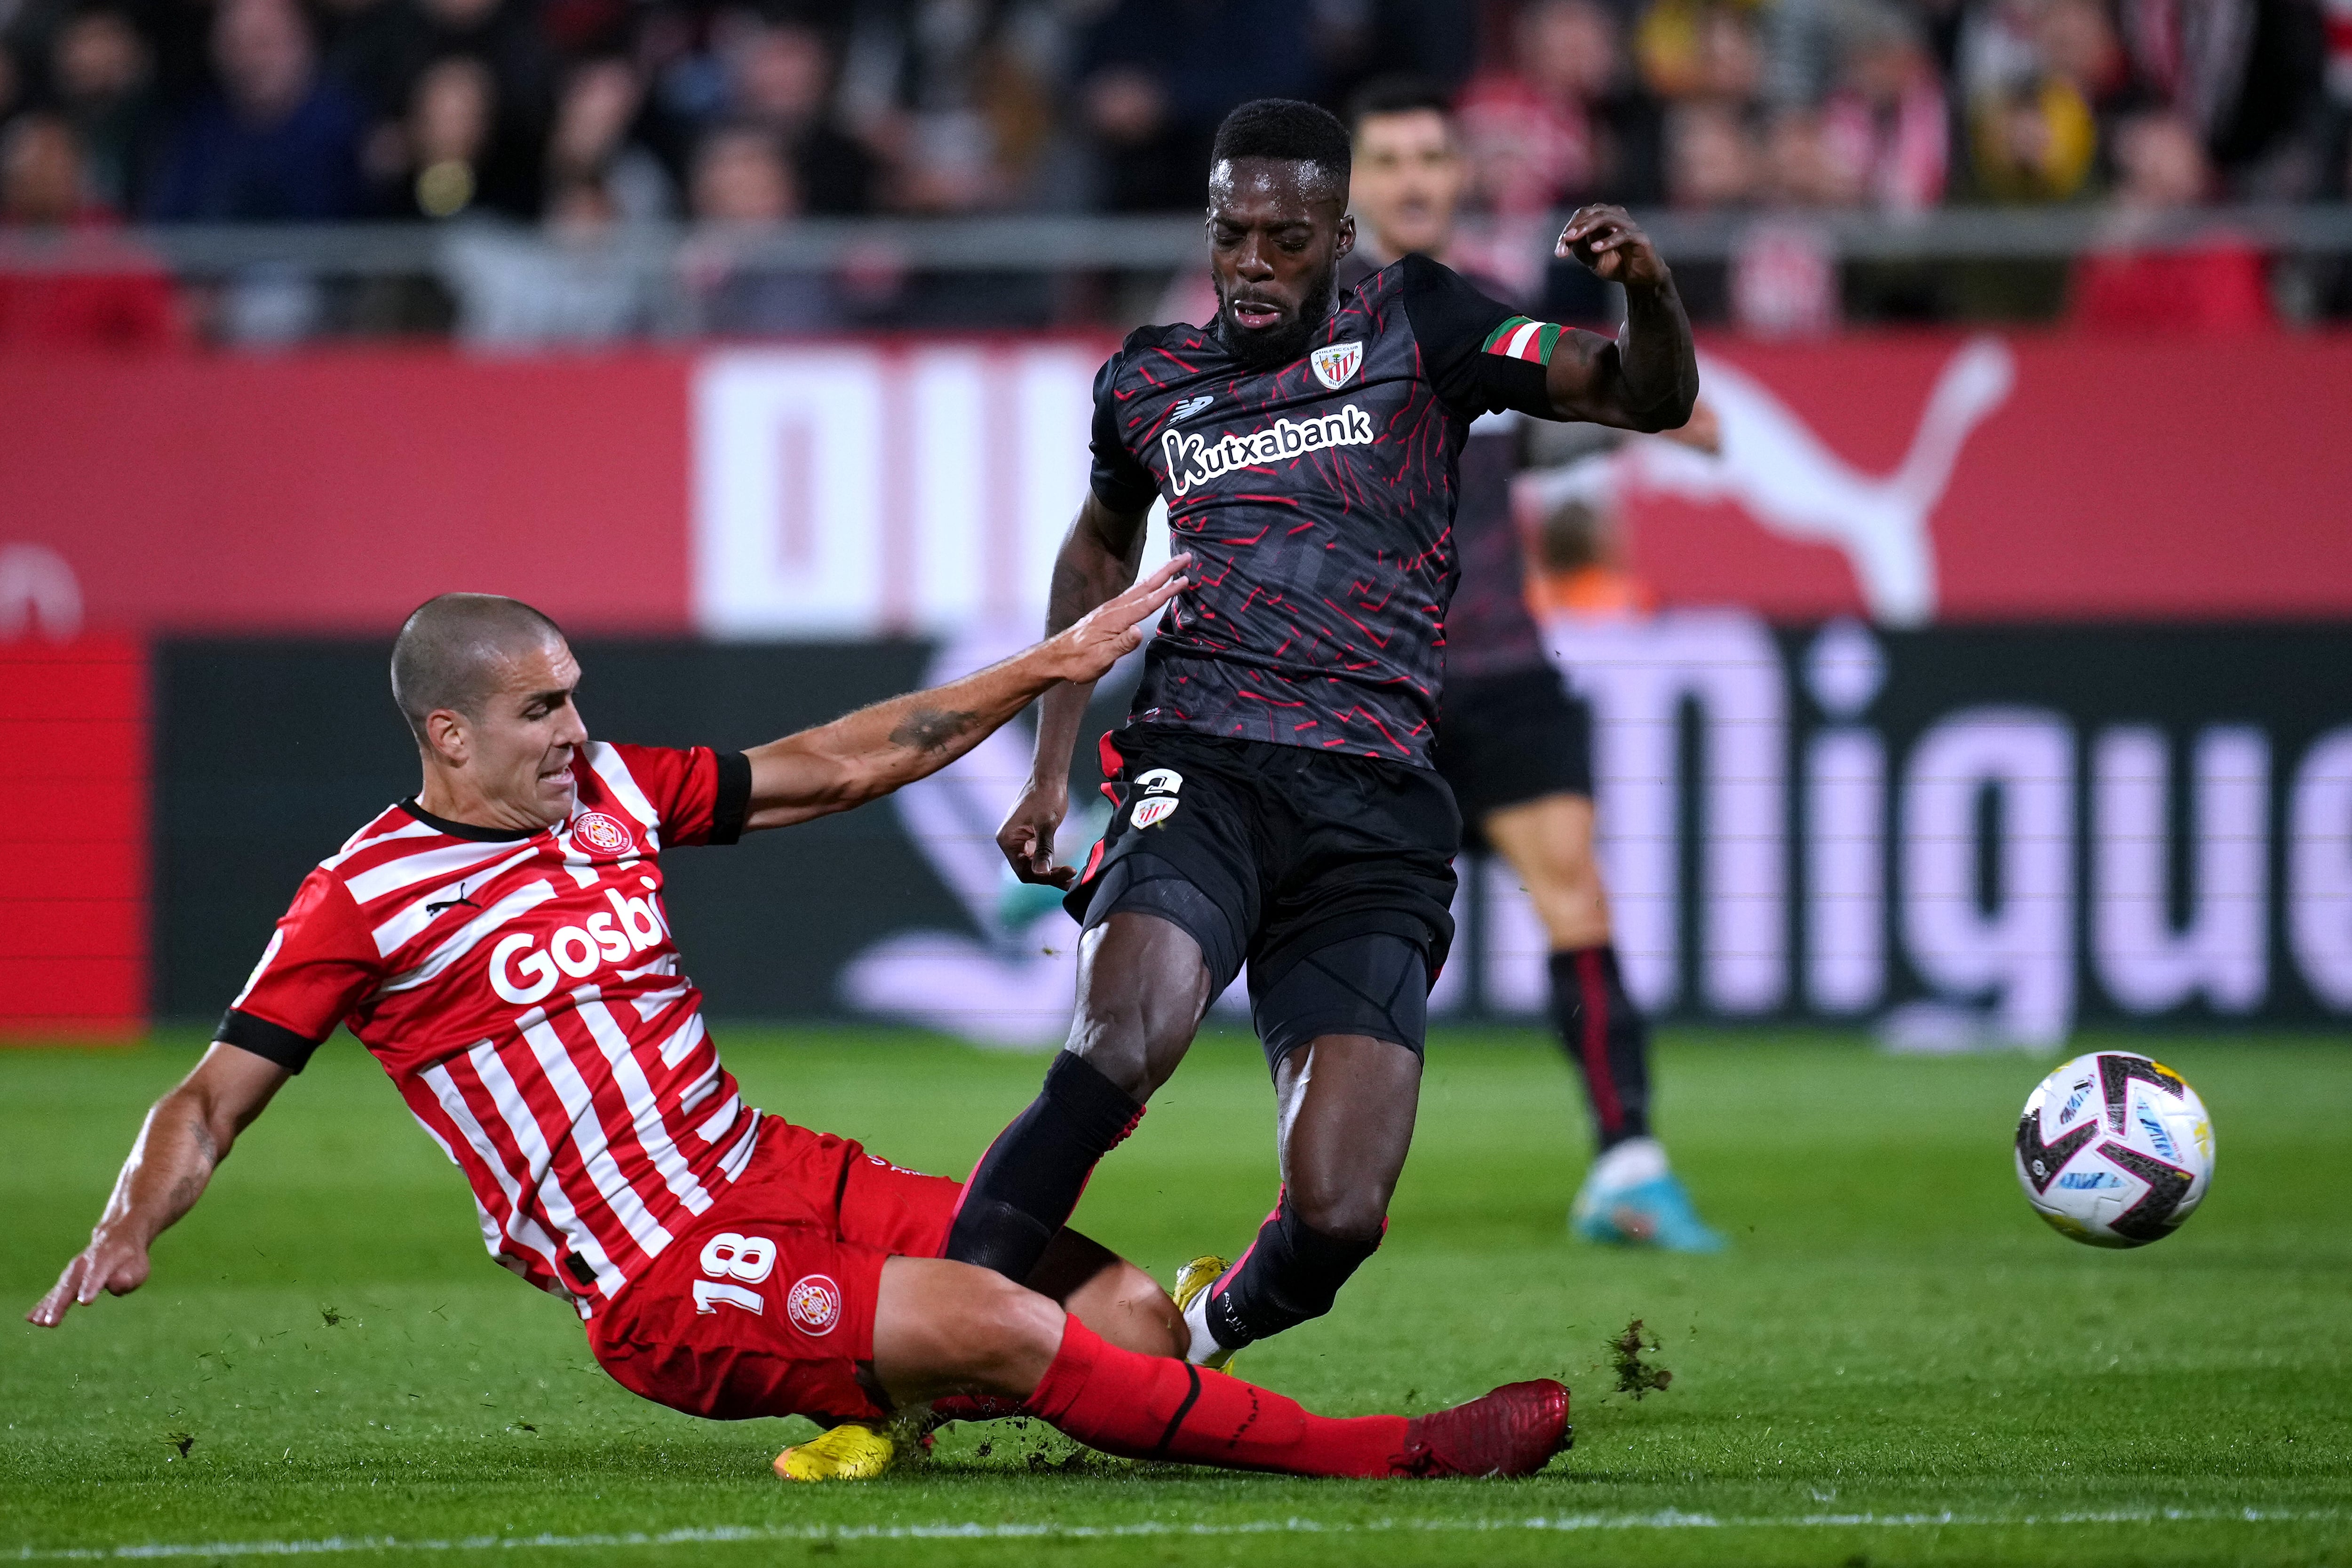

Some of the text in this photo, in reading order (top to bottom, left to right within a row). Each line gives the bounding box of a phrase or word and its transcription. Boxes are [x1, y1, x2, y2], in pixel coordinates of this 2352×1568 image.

[1162, 404, 1374, 496] Kutxabank
[577, 815, 606, 833] GIRONA
[489, 876, 672, 1005] Gosbi
[692, 1233, 777, 1316] 18
